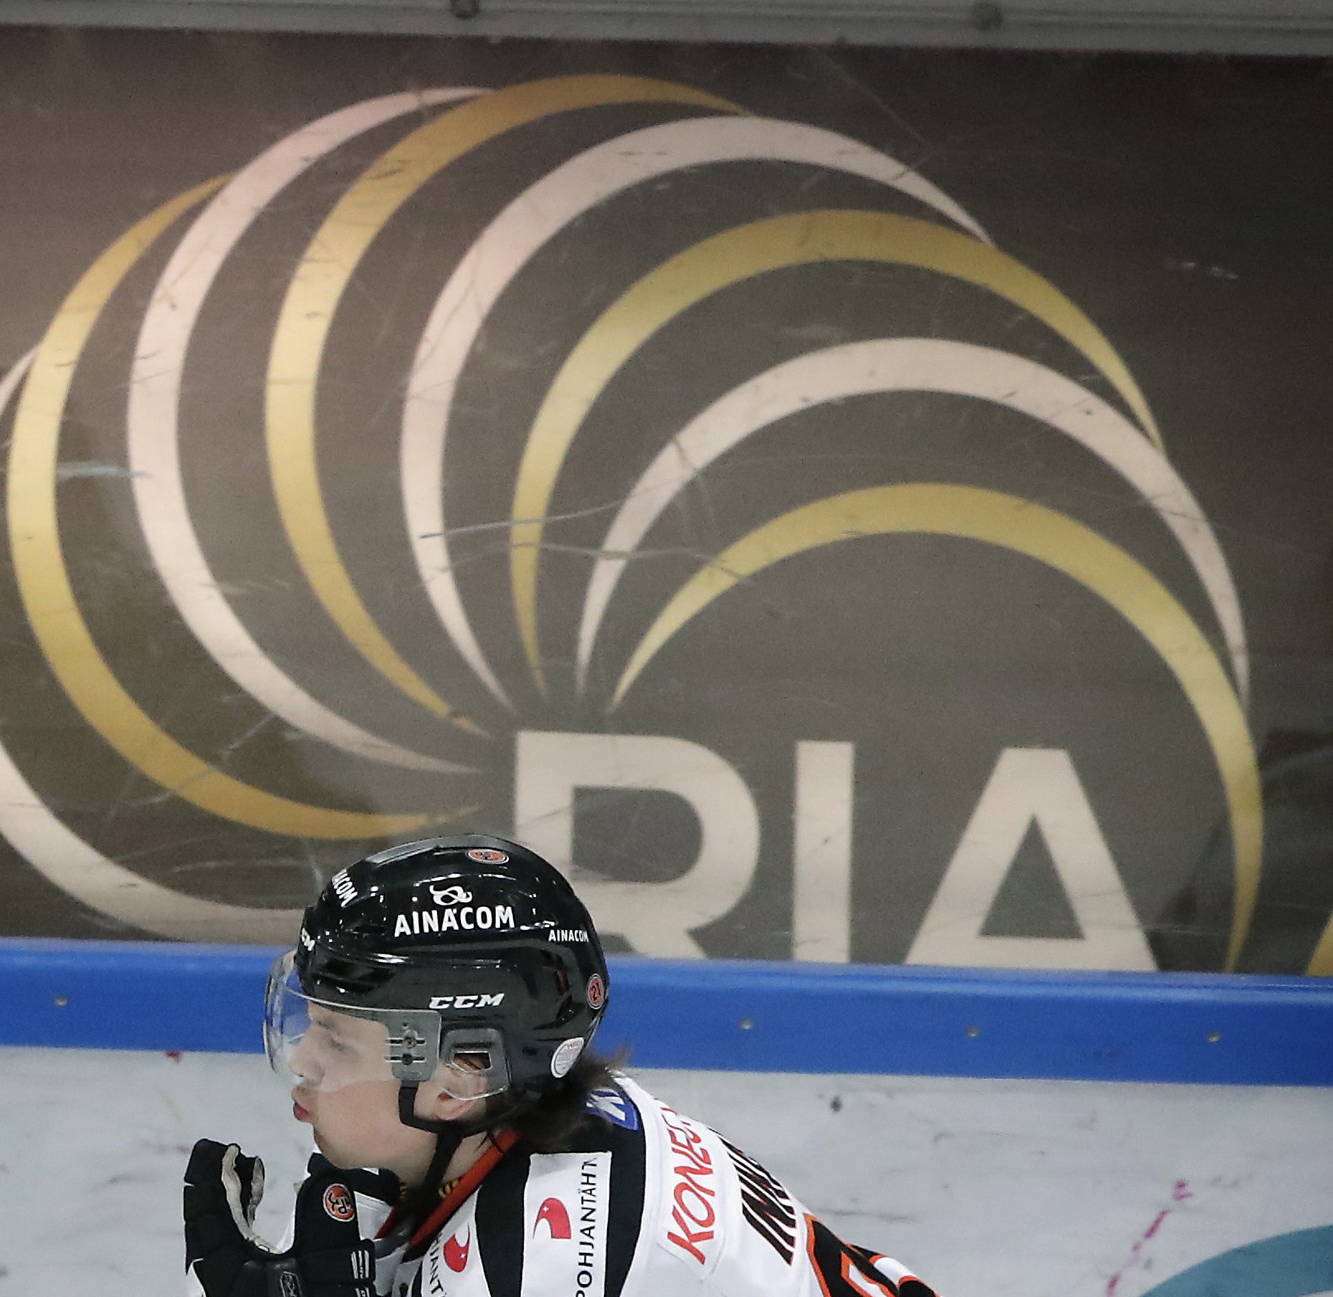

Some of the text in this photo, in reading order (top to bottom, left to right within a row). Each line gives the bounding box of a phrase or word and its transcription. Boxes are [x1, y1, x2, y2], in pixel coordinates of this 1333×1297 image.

[394, 904, 515, 938] AINACOM
[548, 929, 590, 943] AINACOM
[429, 992, 505, 1010] CCM
